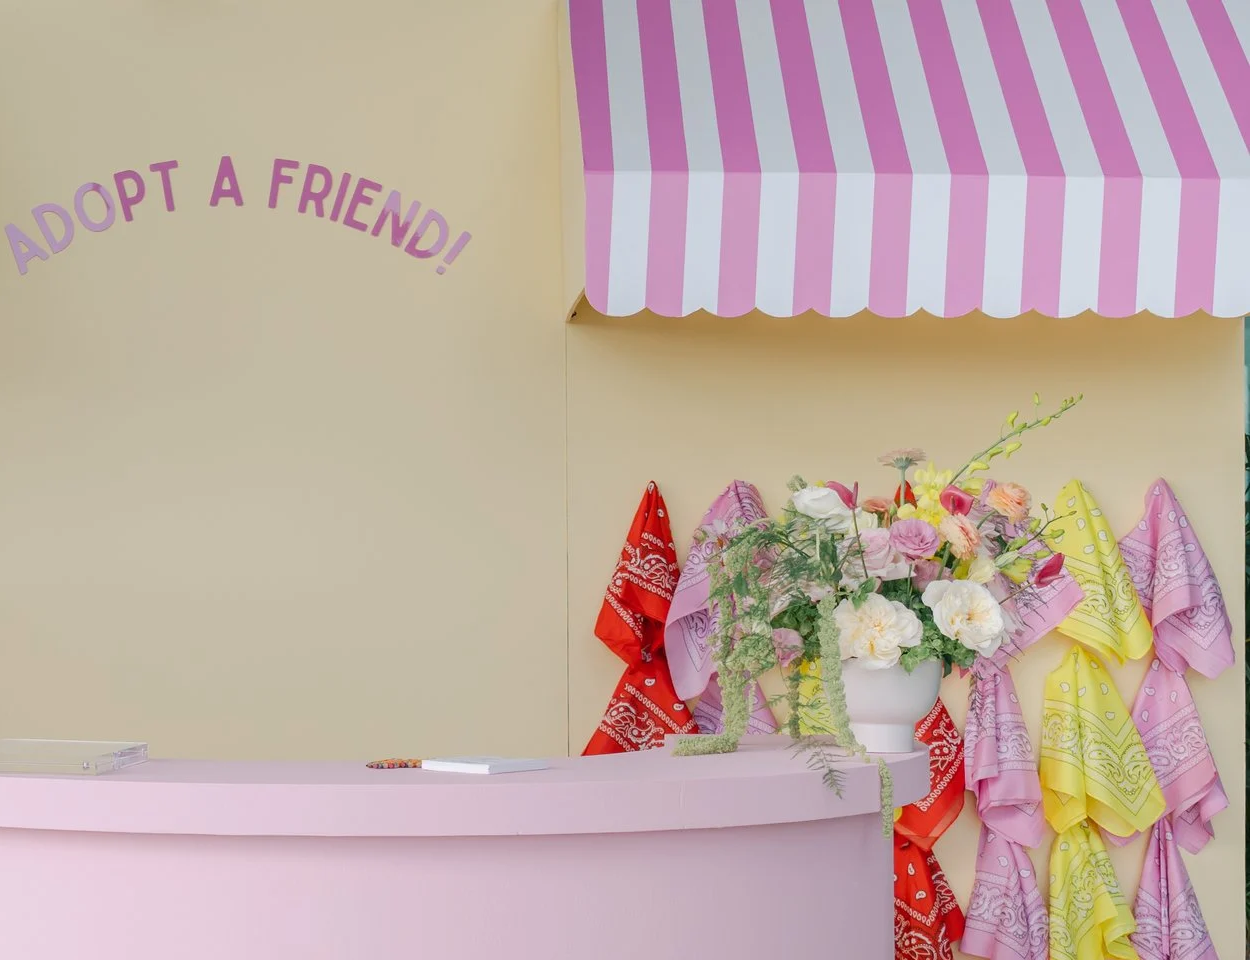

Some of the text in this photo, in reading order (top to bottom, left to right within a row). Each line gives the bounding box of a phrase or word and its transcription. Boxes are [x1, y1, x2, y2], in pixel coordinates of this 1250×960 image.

[4, 155, 472, 275] ADOPT A FRIEND!
